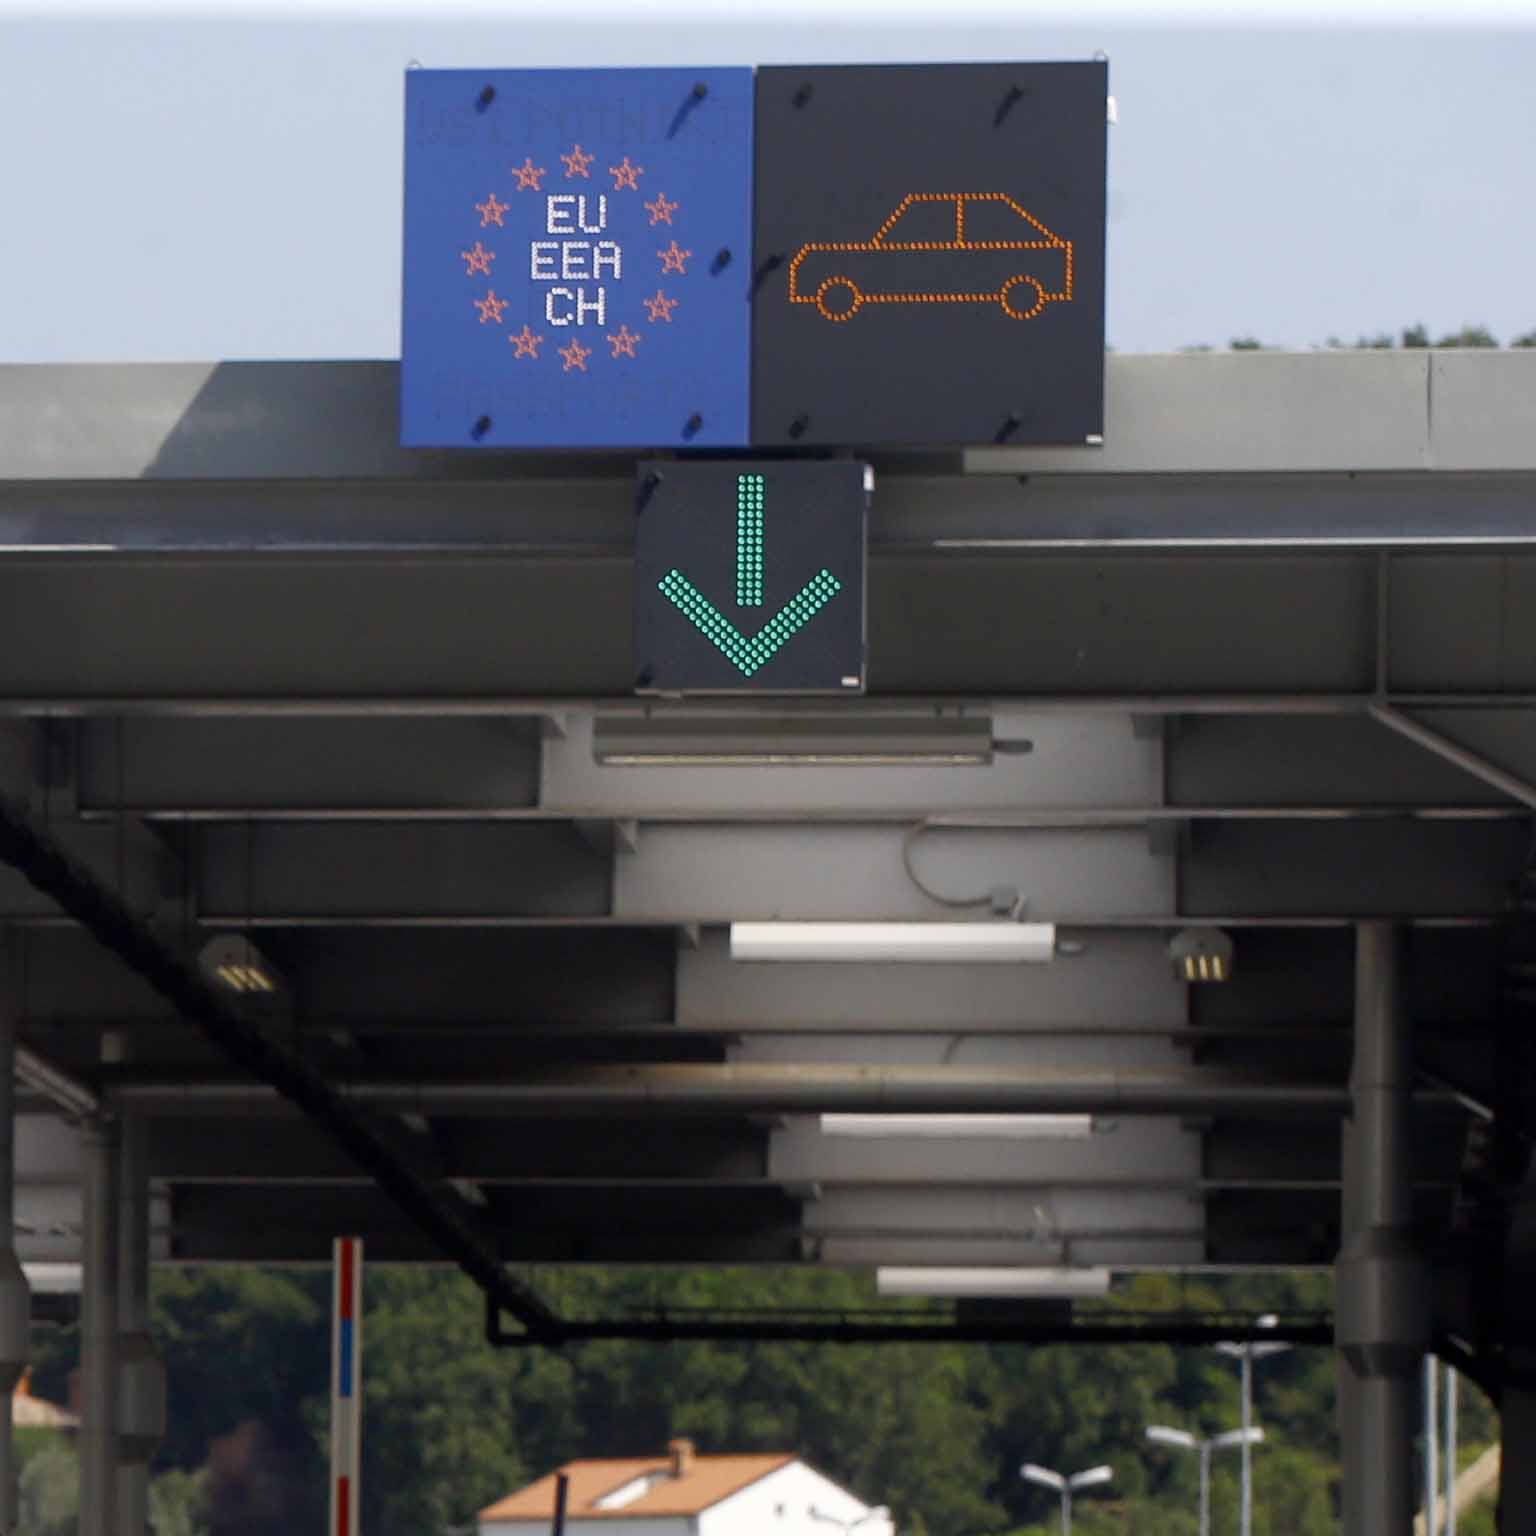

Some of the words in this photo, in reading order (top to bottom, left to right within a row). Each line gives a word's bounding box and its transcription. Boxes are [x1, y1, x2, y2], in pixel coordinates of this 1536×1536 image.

[545, 194, 607, 235] EU
[530, 241, 622, 281] EEA
[544, 286, 606, 327] CH
